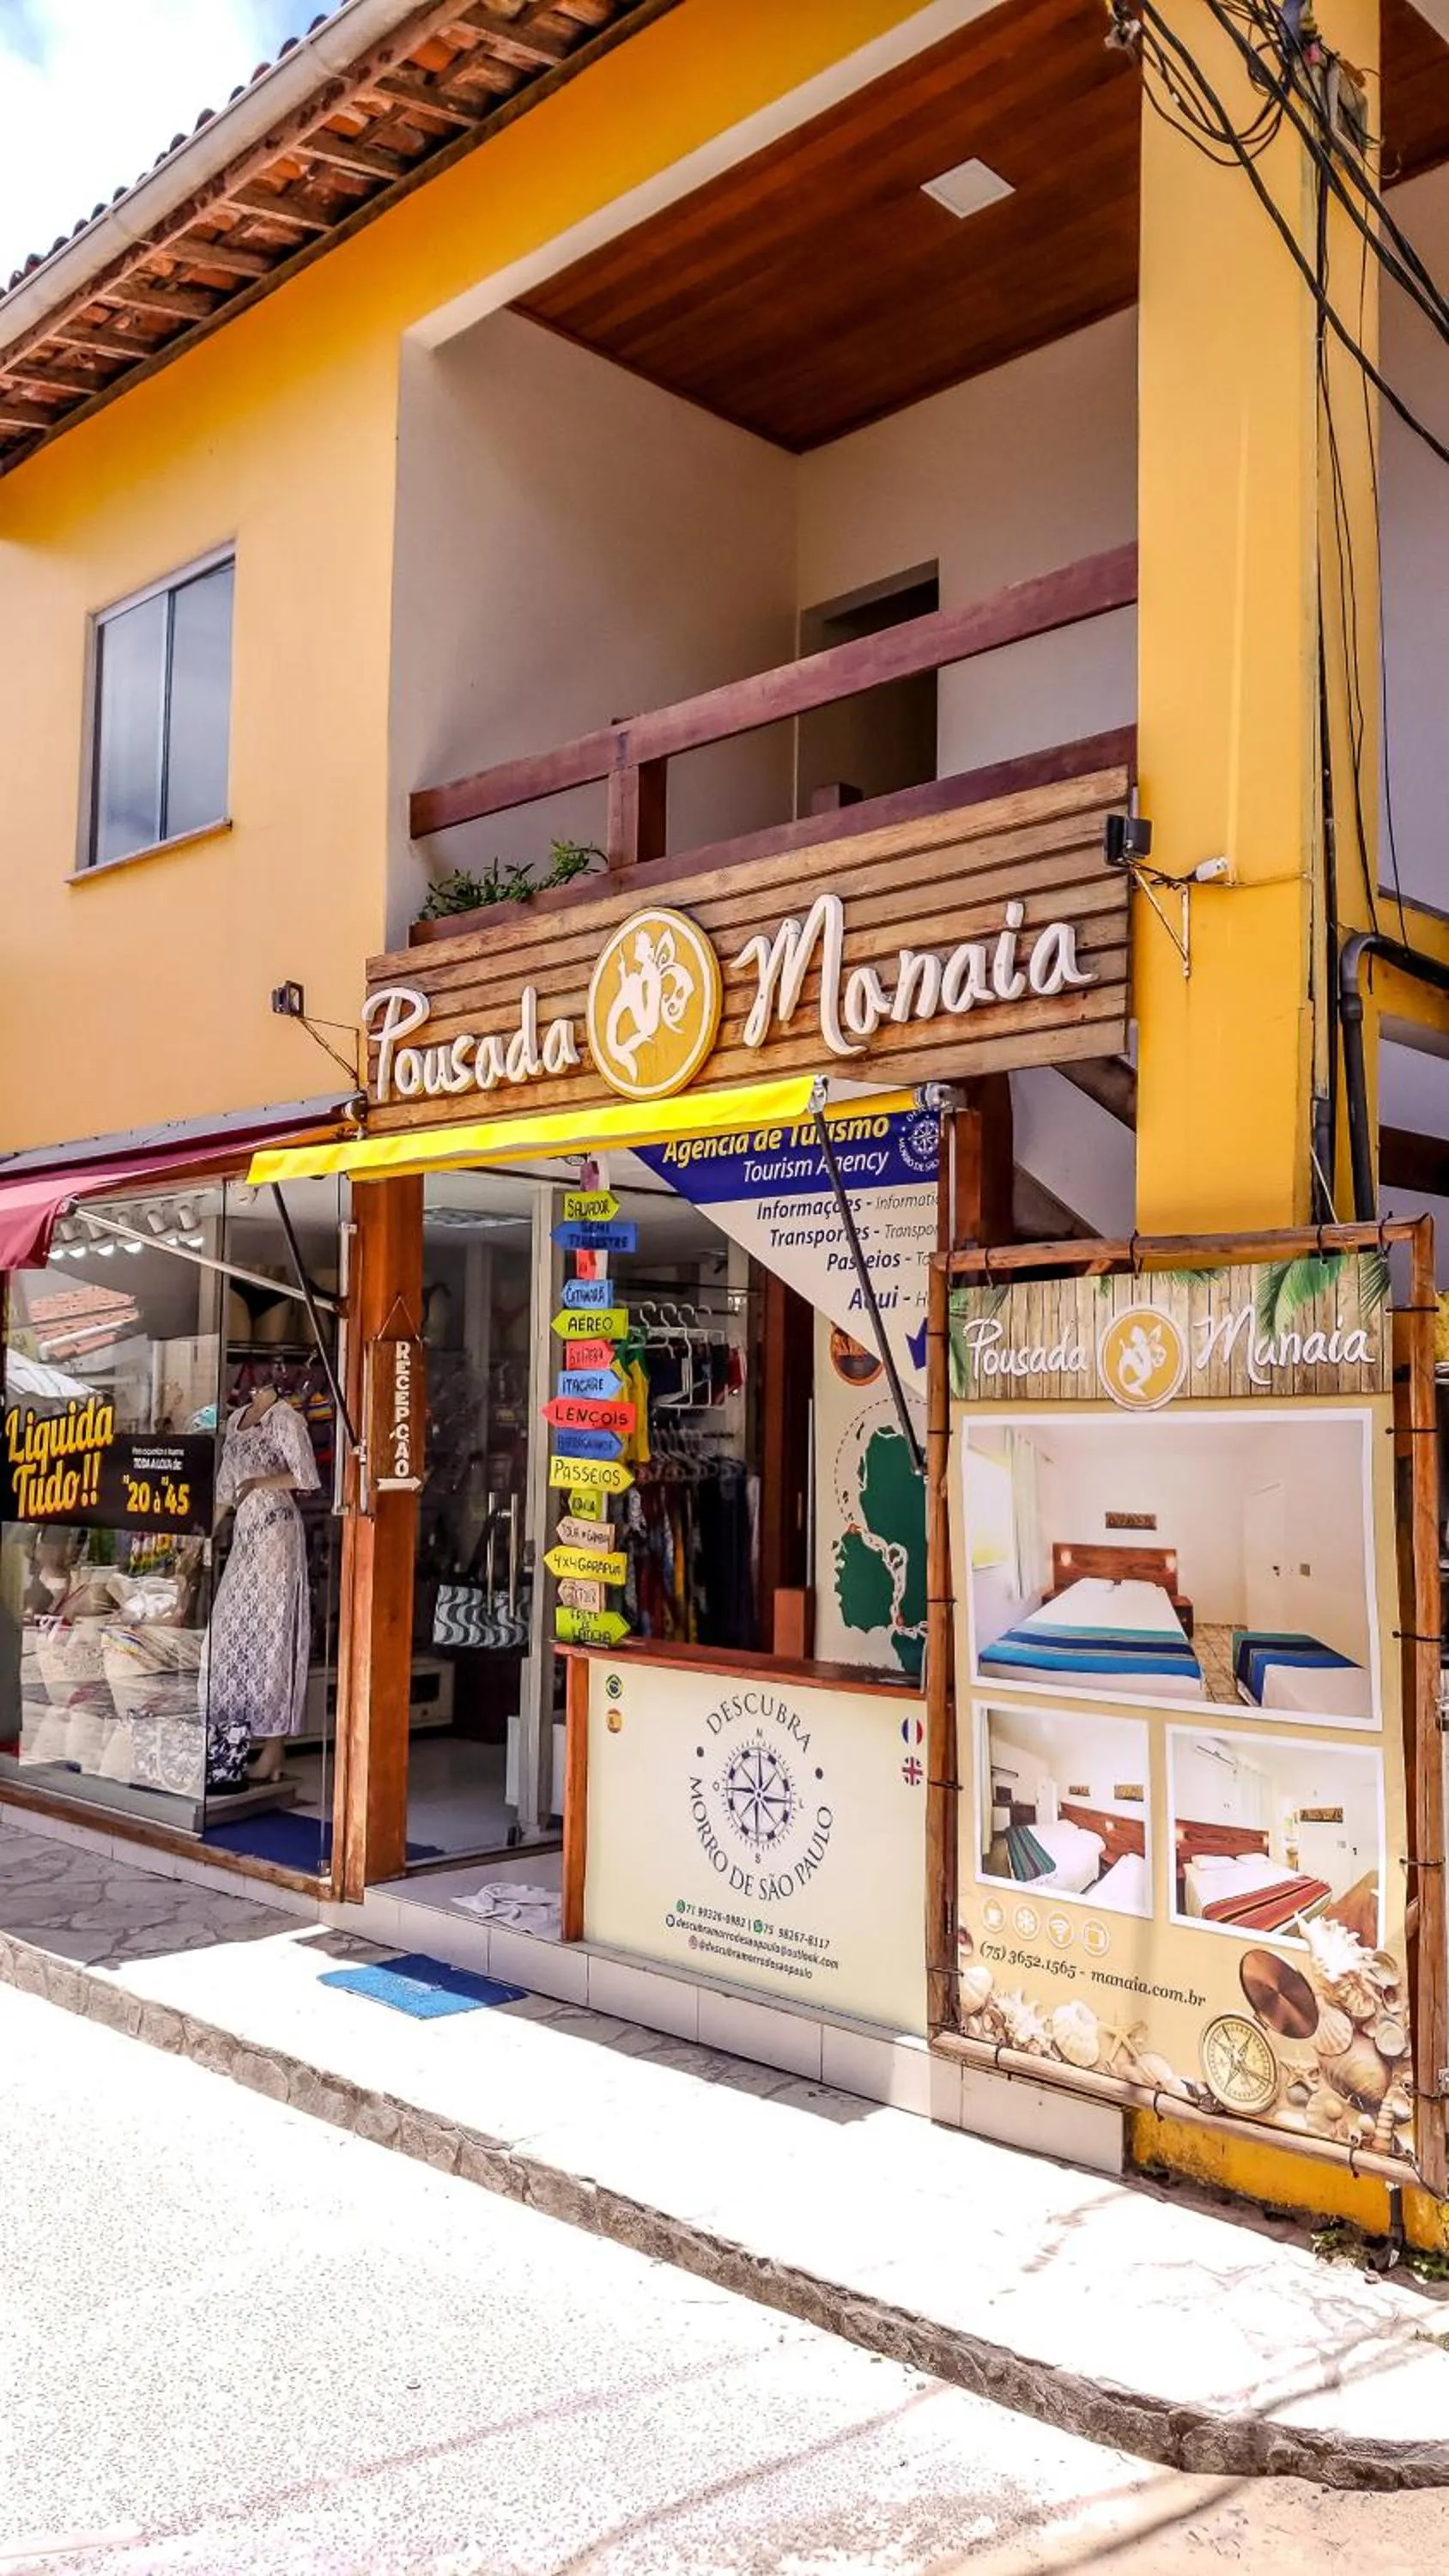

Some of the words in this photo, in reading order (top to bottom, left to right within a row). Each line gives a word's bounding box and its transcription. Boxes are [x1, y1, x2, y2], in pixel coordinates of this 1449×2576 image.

[361, 986, 581, 1101] Pousada
[731, 893, 1100, 1057] Manaia
[743, 1157, 813, 1182] Tourism
[754, 1128, 782, 1151] de
[963, 1317, 1088, 1380] Pousada
[1193, 1303, 1376, 1386] Manaia
[5, 1396, 115, 1474] Liquida
[11, 1451, 102, 1520] Tudo!!
[127, 1482, 150, 1512] 20
[165, 1483, 190, 1516] 45
[554, 1459, 621, 1487] PASSEIOS
[706, 1692, 811, 1753] DESCUBRA
[689, 1777, 729, 1873] MORRO
[729, 1865, 753, 1897] DE
[759, 1873, 794, 1902] SÃO
[794, 1806, 834, 1885] PAULO
[979, 1940, 1007, 1962] (75)
[1008, 1950, 1077, 1978] 3652.1565
[1091, 1968, 1207, 2008] manaia.com.br
